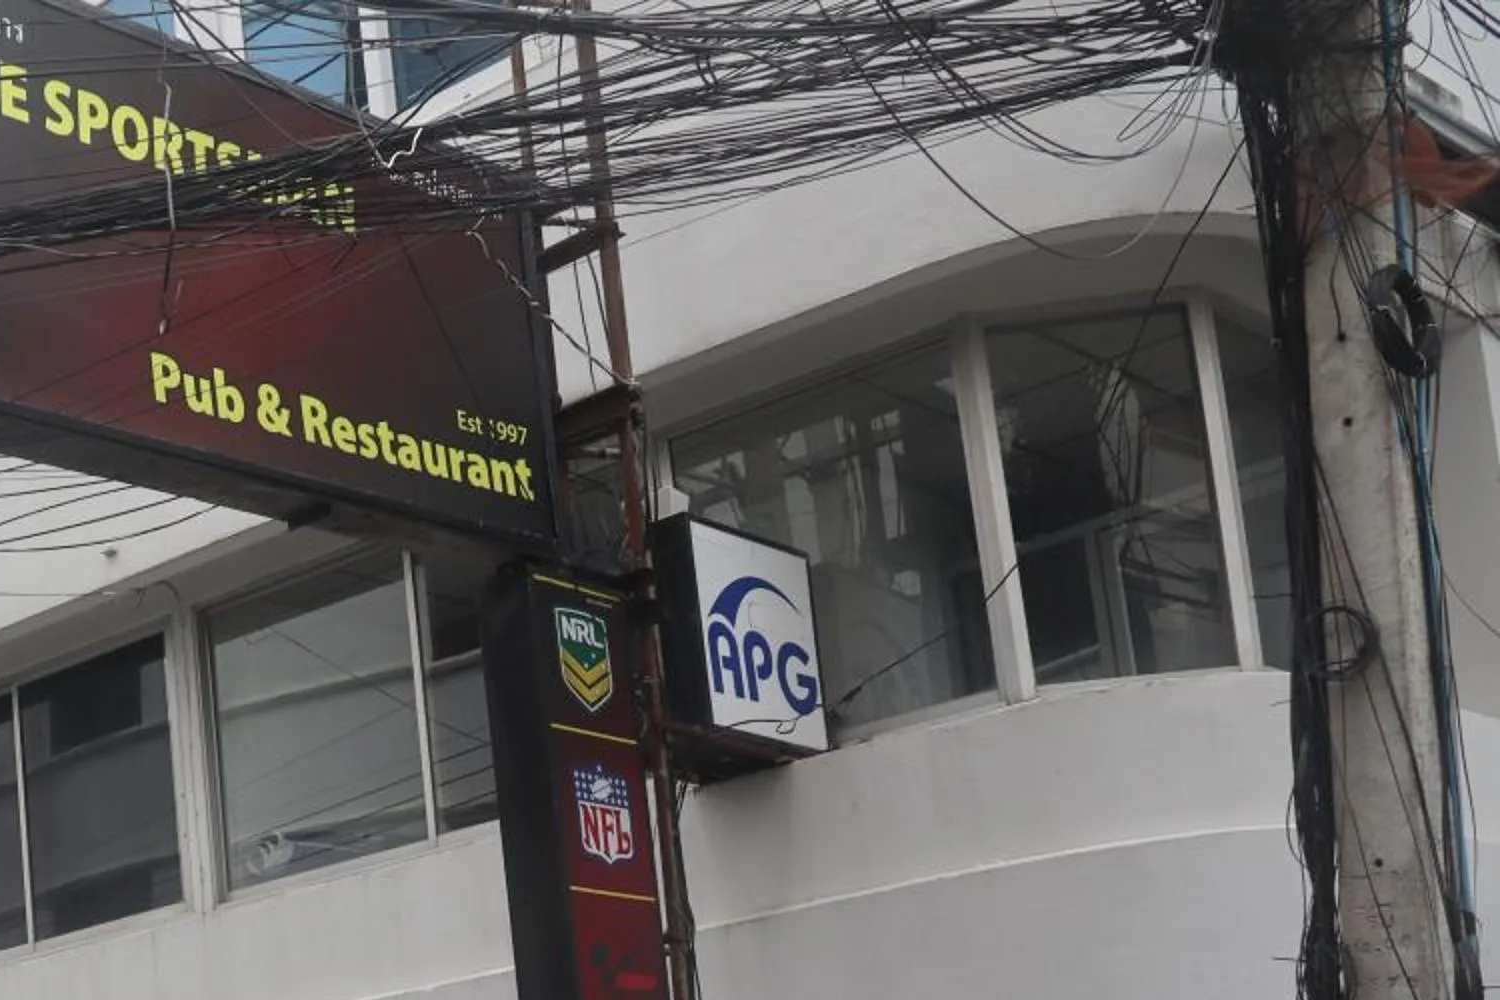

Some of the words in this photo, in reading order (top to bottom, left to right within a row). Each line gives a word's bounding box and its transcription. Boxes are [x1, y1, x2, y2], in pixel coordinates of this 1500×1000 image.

[150, 351, 245, 423] Pub
[256, 383, 293, 437] &
[299, 393, 534, 501] Restaurant
[457, 409, 484, 435] Est
[561, 615, 605, 649] NRL
[707, 621, 819, 717] APG
[582, 804, 631, 855] NFL
